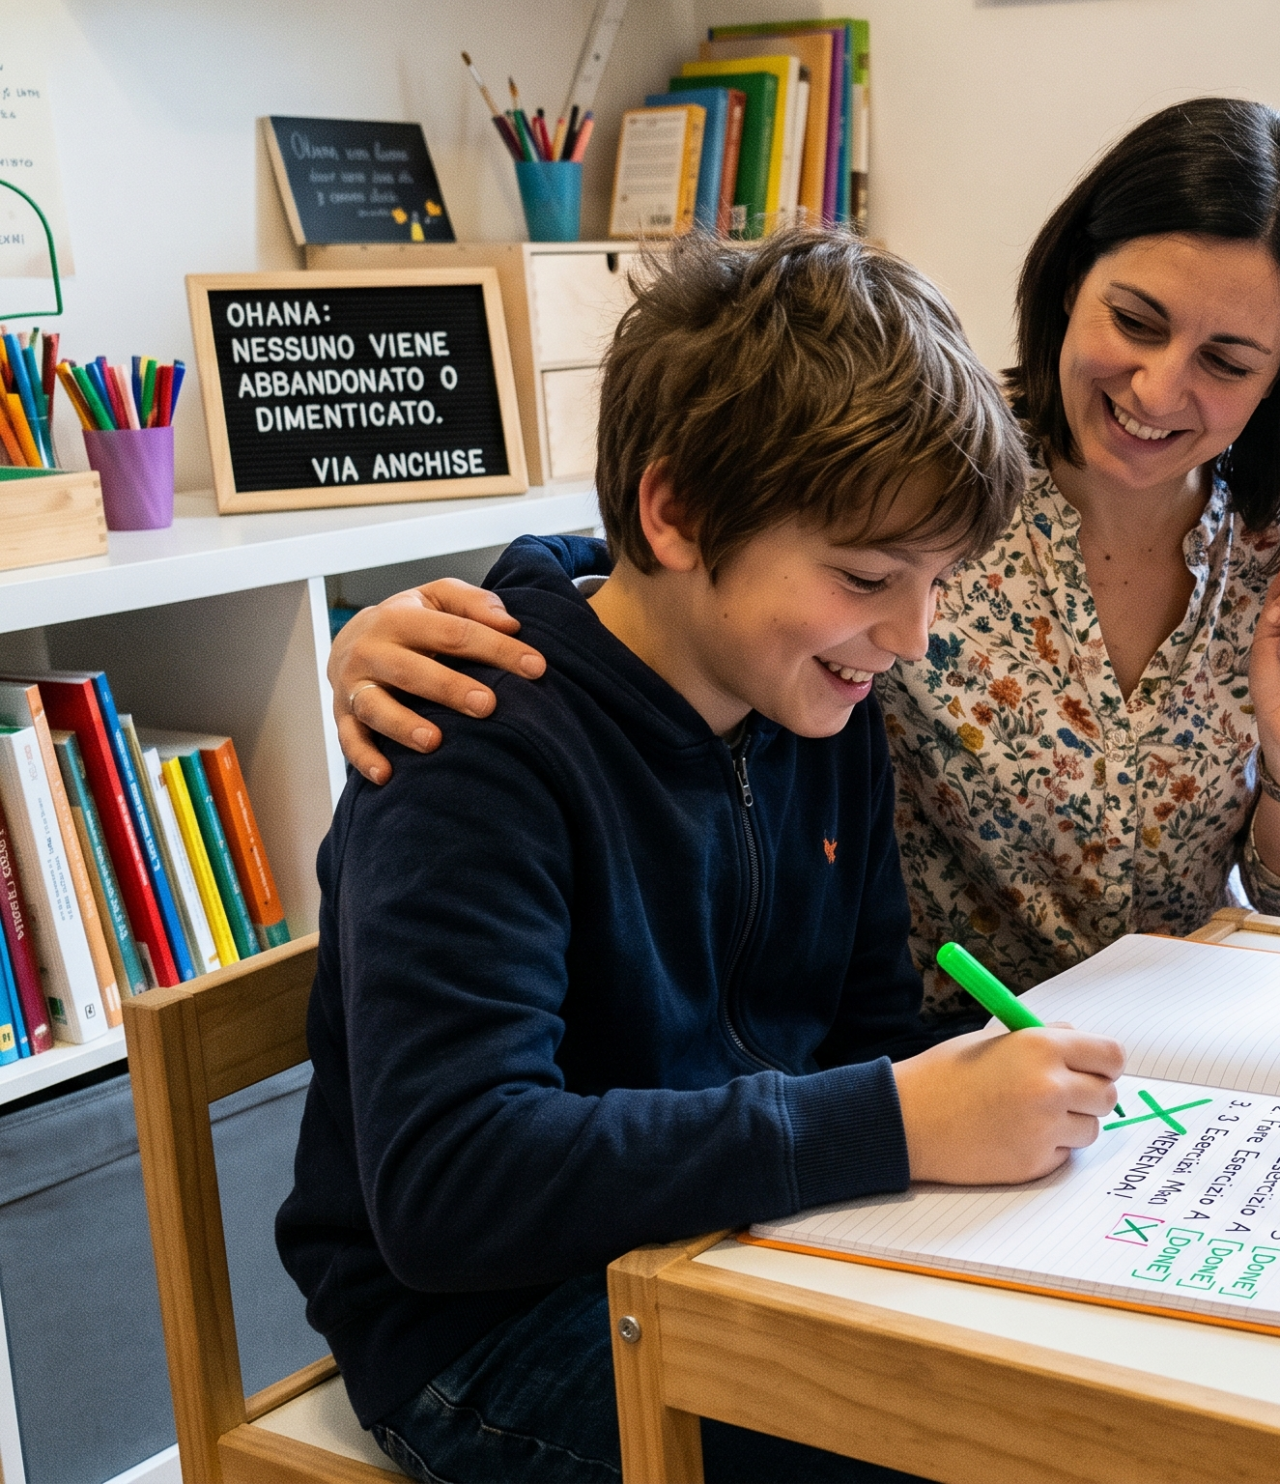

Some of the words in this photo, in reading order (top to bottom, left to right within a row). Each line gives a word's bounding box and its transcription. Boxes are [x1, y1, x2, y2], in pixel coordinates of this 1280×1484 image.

[226, 301, 331, 327] OHANA:
[231, 334, 355, 364] NESSUNO
[368, 331, 450, 358] VIENE
[238, 367, 425, 398] ABBANDONATO
[439, 365, 458, 390] O
[255, 400, 443, 433] DIMENTICATO.
[311, 456, 359, 484] VIA
[372, 448, 486, 480] ANCHISE
[1217, 1114, 1240, 1122] 3
[1228, 1099, 1252, 1109] 3.
[1106, 1130, 1180, 1199] MERENDA!
[1199, 1149, 1261, 1206] Esercizio
[1183, 1209, 1211, 1220] A
[1225, 1221, 1252, 1232] A
[1130, 1227, 1205, 1283] [DONE]
[1175, 1238, 1244, 1291] [DONE]
